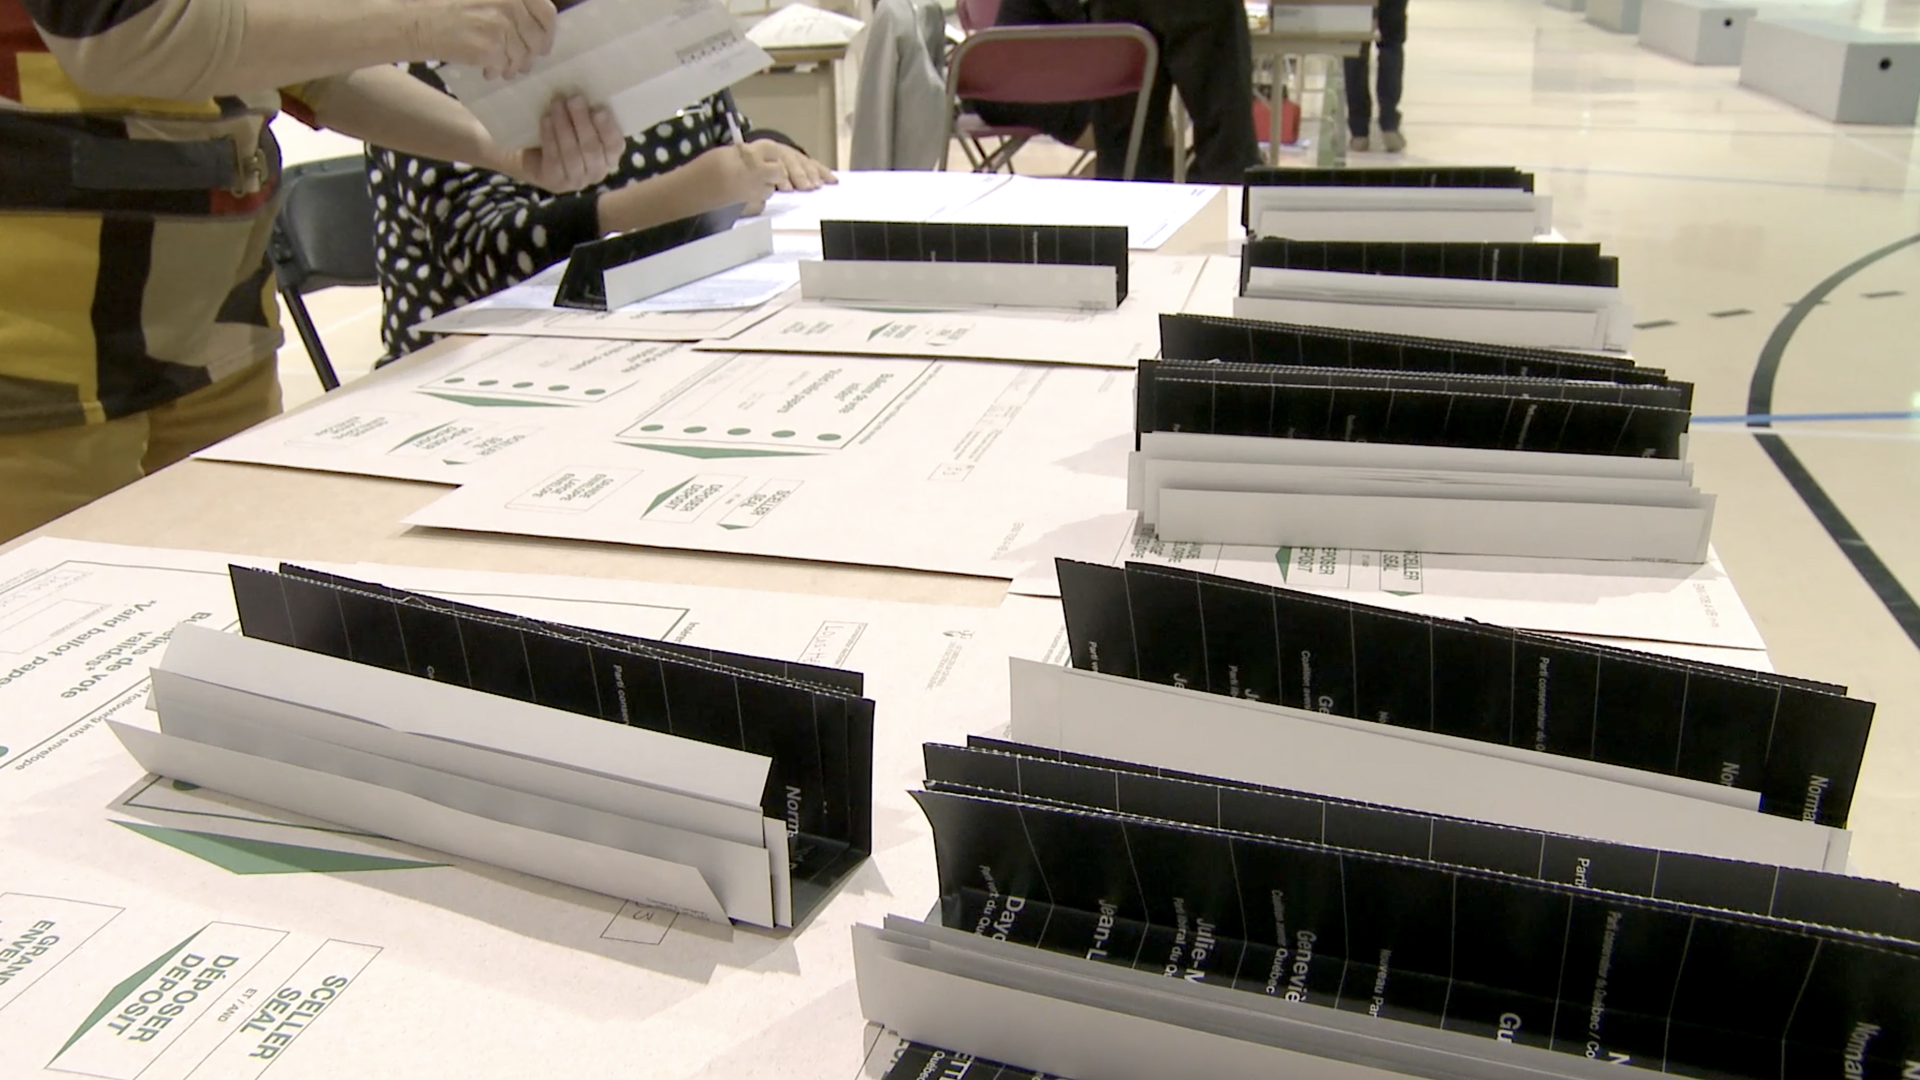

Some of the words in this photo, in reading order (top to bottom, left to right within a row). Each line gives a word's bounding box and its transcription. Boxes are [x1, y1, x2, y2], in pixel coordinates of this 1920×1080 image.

[1383, 553, 1399, 572] SEAL
[47, 626, 106, 658] ballot
[105, 655, 134, 672] de
[613, 664, 625, 688] Parti
[60, 673, 108, 699] vote
[68, 721, 95, 738] into
[15, 736, 69, 771] envelope
[1169, 945, 1183, 962] du
[1265, 948, 1289, 993] Québec
[107, 953, 205, 1036] DEPOSIT
[128, 954, 239, 1043] DÉPOSER
[245, 987, 258, 1000] ET
[217, 1003, 240, 1022] AND
[239, 987, 302, 1034] SEAL
[248, 975, 349, 1060] SCELLER
